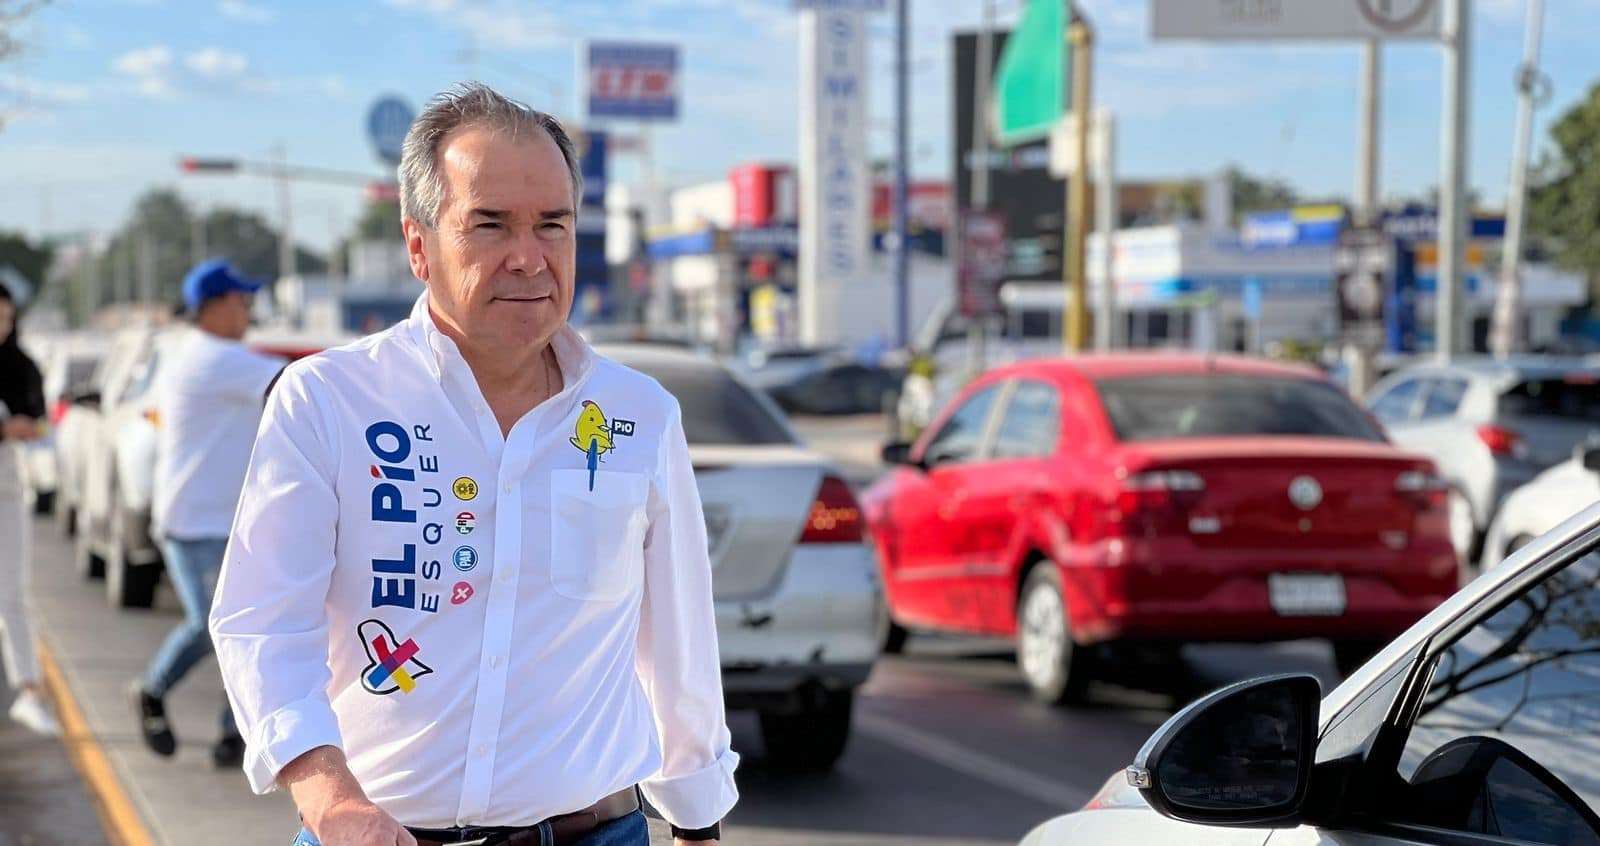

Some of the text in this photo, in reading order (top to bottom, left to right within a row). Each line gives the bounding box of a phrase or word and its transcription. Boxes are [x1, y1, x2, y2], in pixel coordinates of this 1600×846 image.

[416, 424, 443, 613] ESQUER
[457, 513, 471, 533] PRI
[372, 544, 415, 609] EL
[460, 550, 472, 567] PAN
